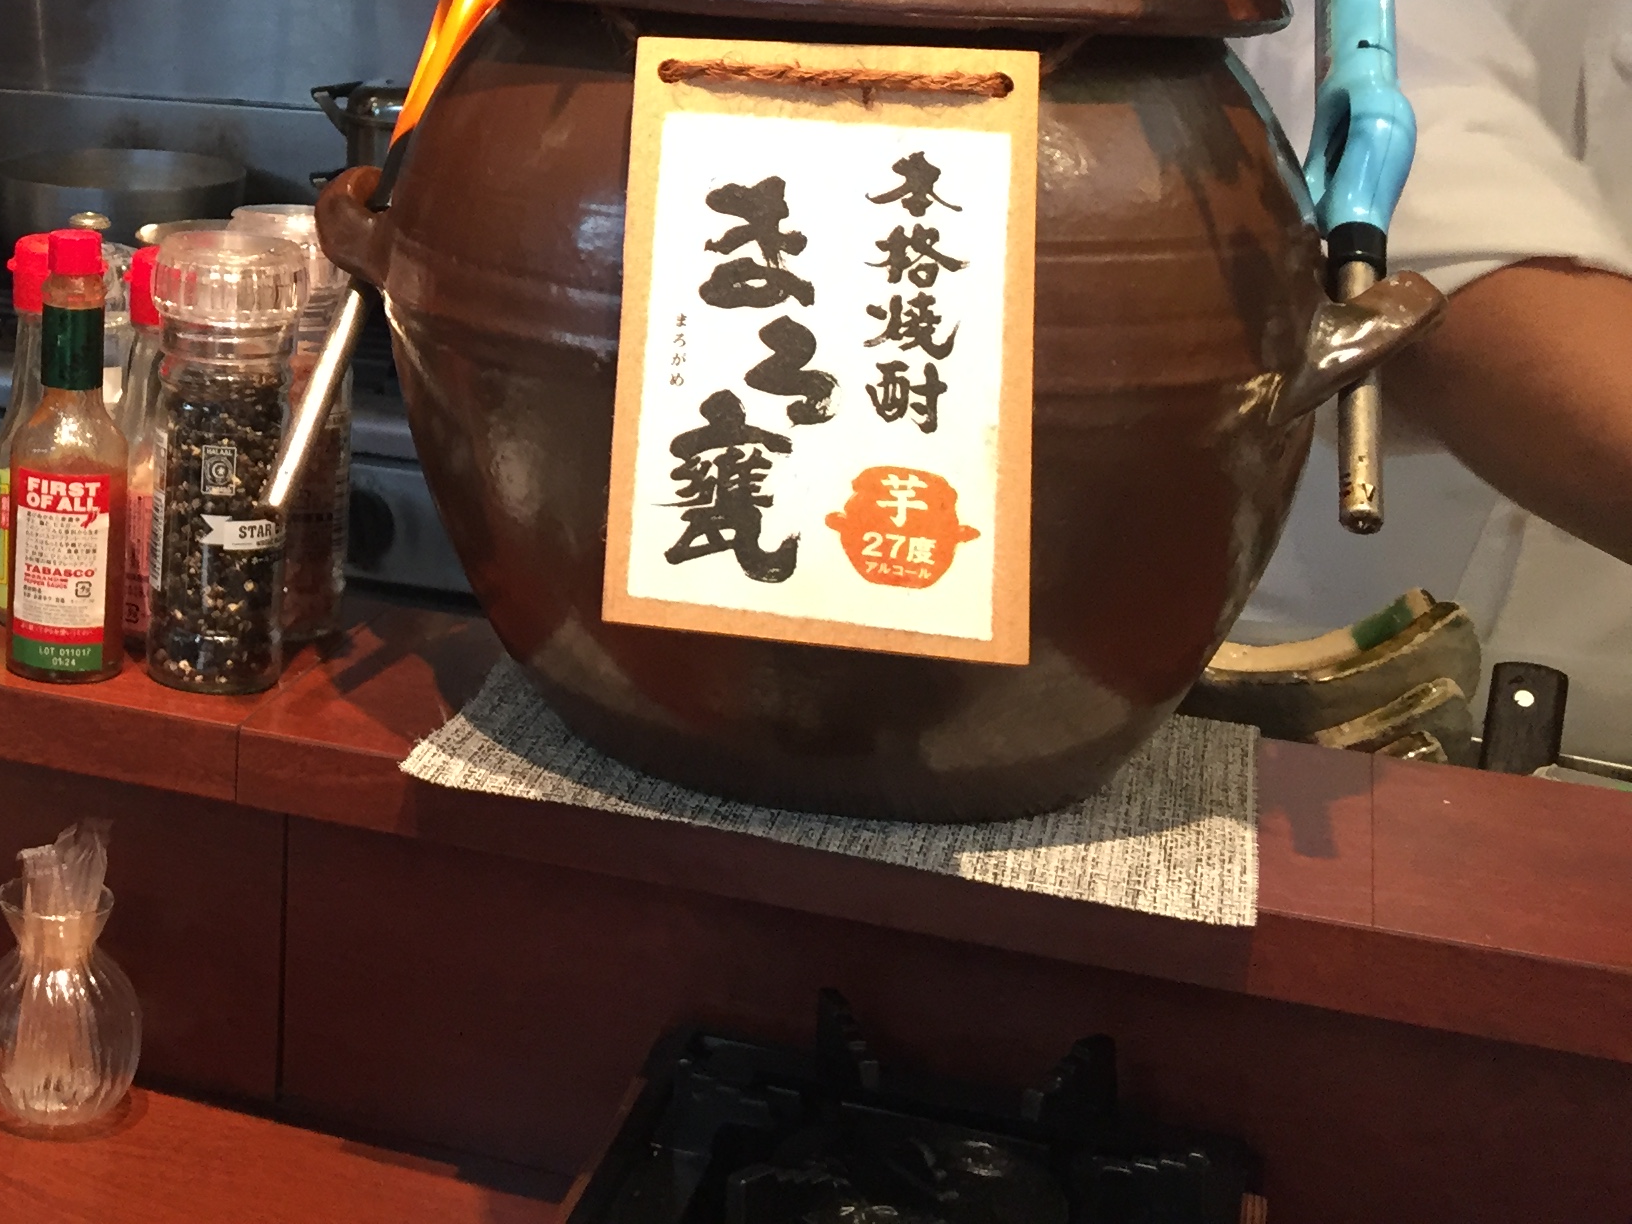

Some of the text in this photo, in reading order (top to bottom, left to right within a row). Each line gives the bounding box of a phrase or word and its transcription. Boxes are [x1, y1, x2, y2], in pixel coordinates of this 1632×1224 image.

[669, 312, 687, 387] まろがめ
[28, 476, 101, 497] FIRST
[26, 492, 100, 512] OF ALL
[876, 473, 928, 527] 芋
[238, 523, 272, 539] STAR
[861, 531, 937, 565] 27度
[24, 562, 95, 578] TABASCO
[865, 561, 932, 579] アルコール
[38, 646, 55, 656] LOT
